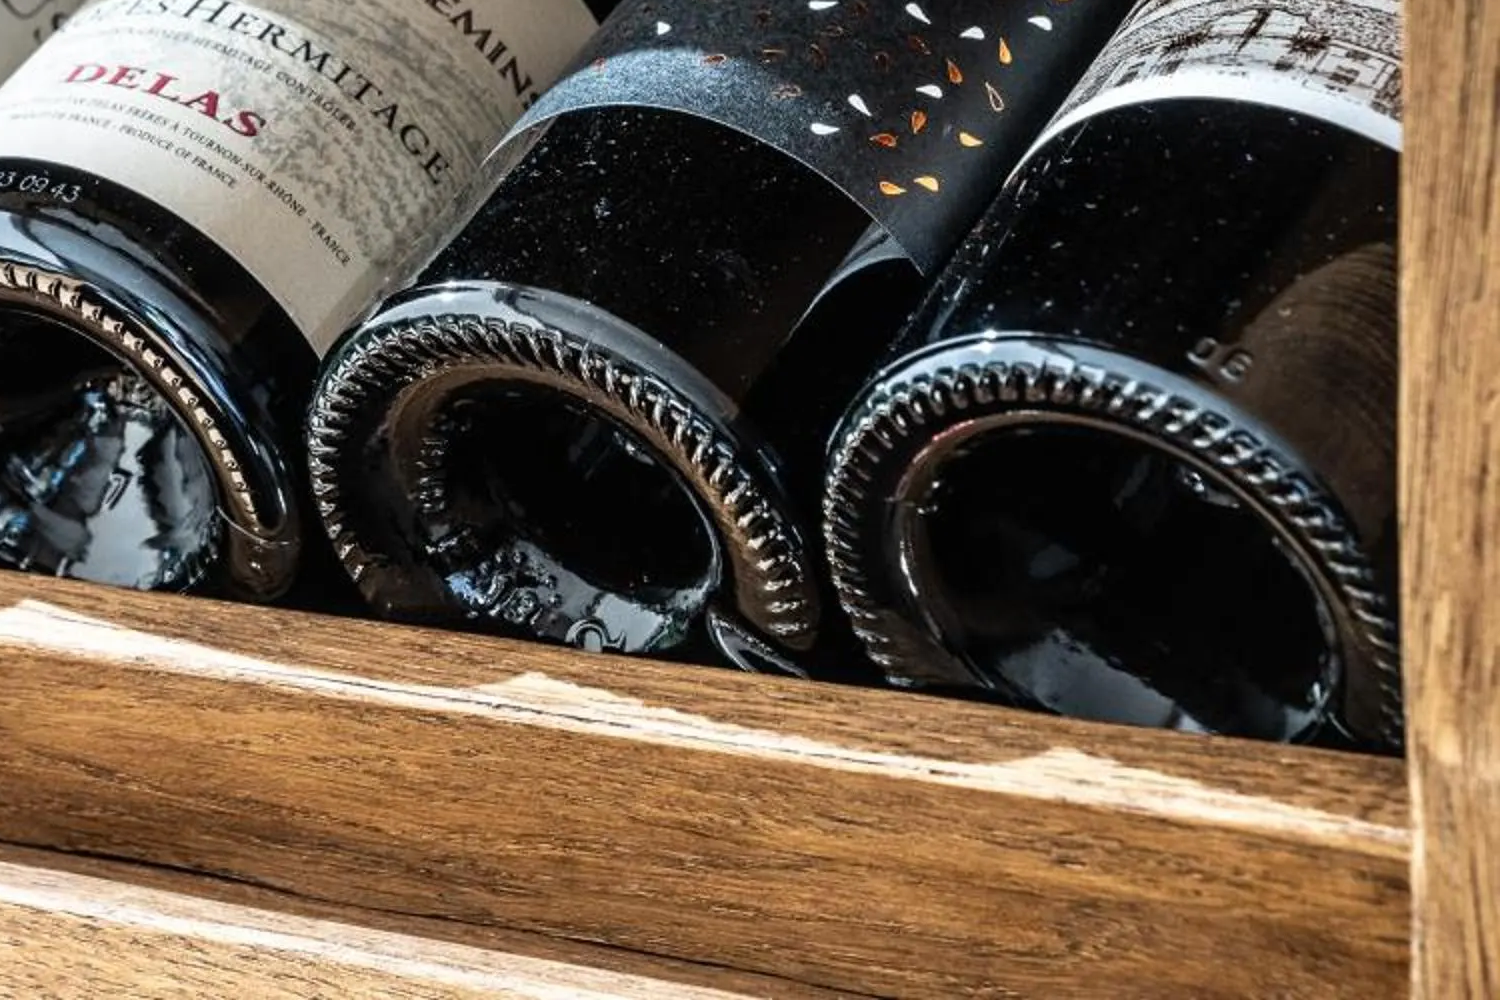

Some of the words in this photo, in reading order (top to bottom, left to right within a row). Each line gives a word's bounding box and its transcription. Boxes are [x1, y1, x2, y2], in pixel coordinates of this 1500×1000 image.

[65, 62, 267, 138] DELAS
[174, 146, 193, 160] OF
[192, 155, 237, 189] FRANCE
[310, 220, 351, 267] FRANCE
